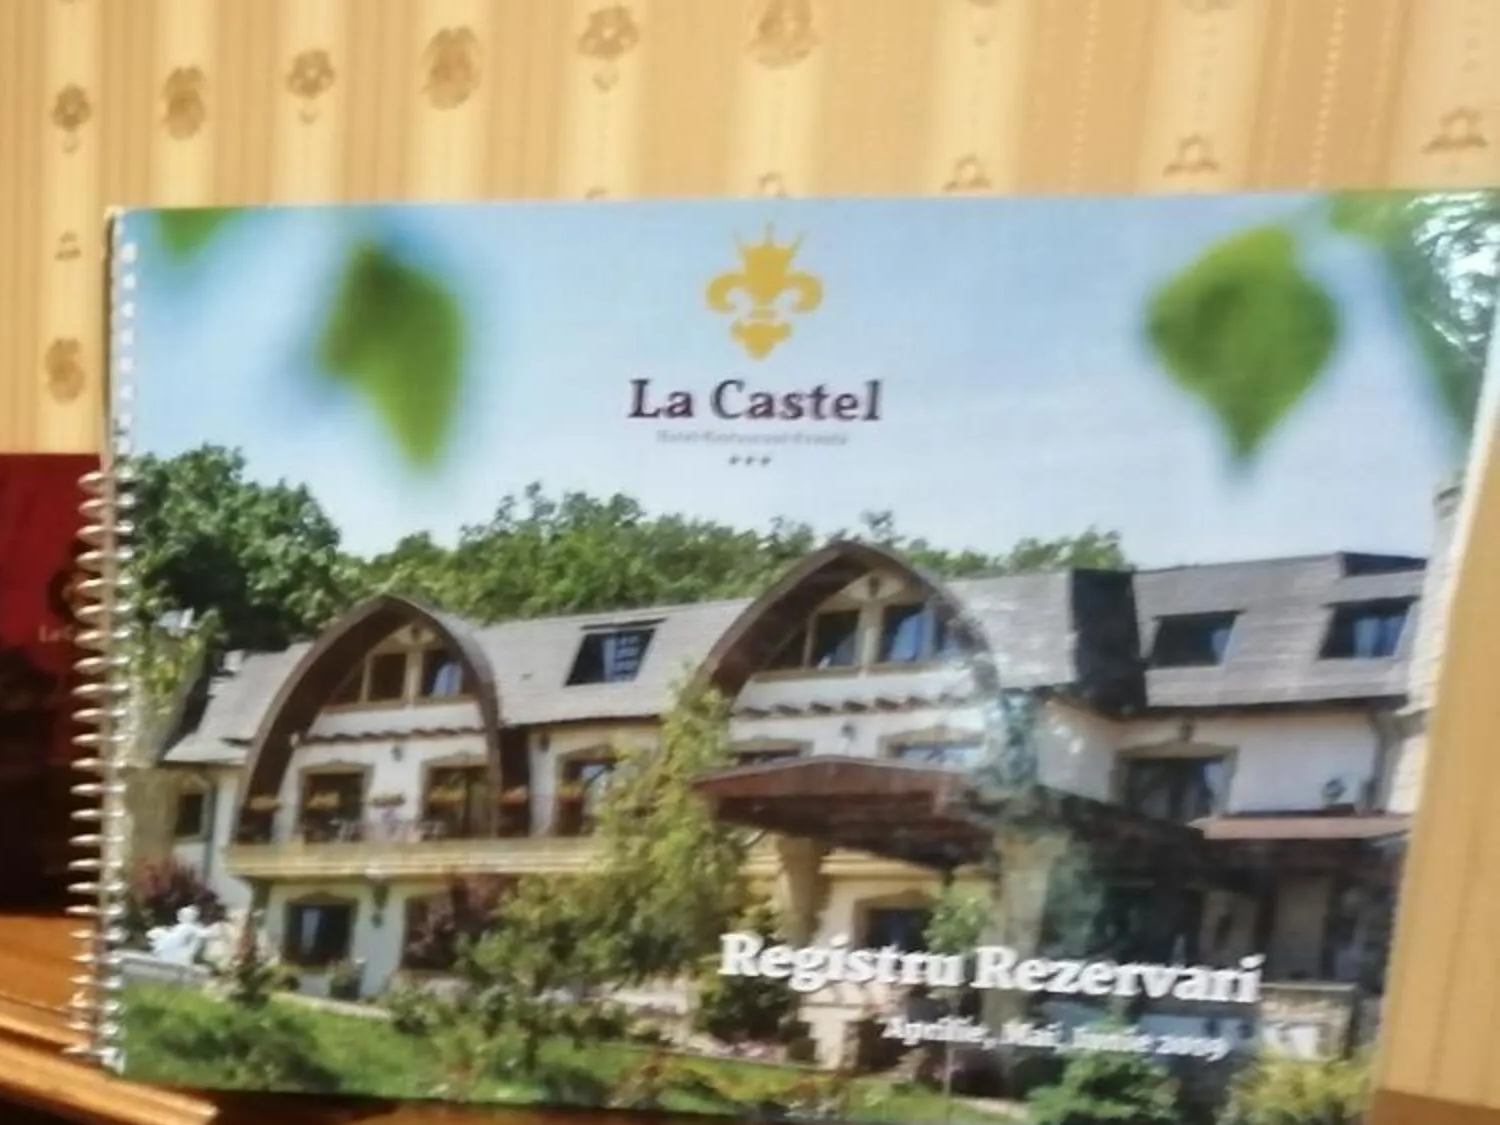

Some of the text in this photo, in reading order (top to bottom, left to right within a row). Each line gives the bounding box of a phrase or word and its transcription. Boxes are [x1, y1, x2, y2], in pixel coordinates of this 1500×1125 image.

[628, 378, 885, 422] La Castel
[720, 933, 1265, 1003] Registru Rezervari
